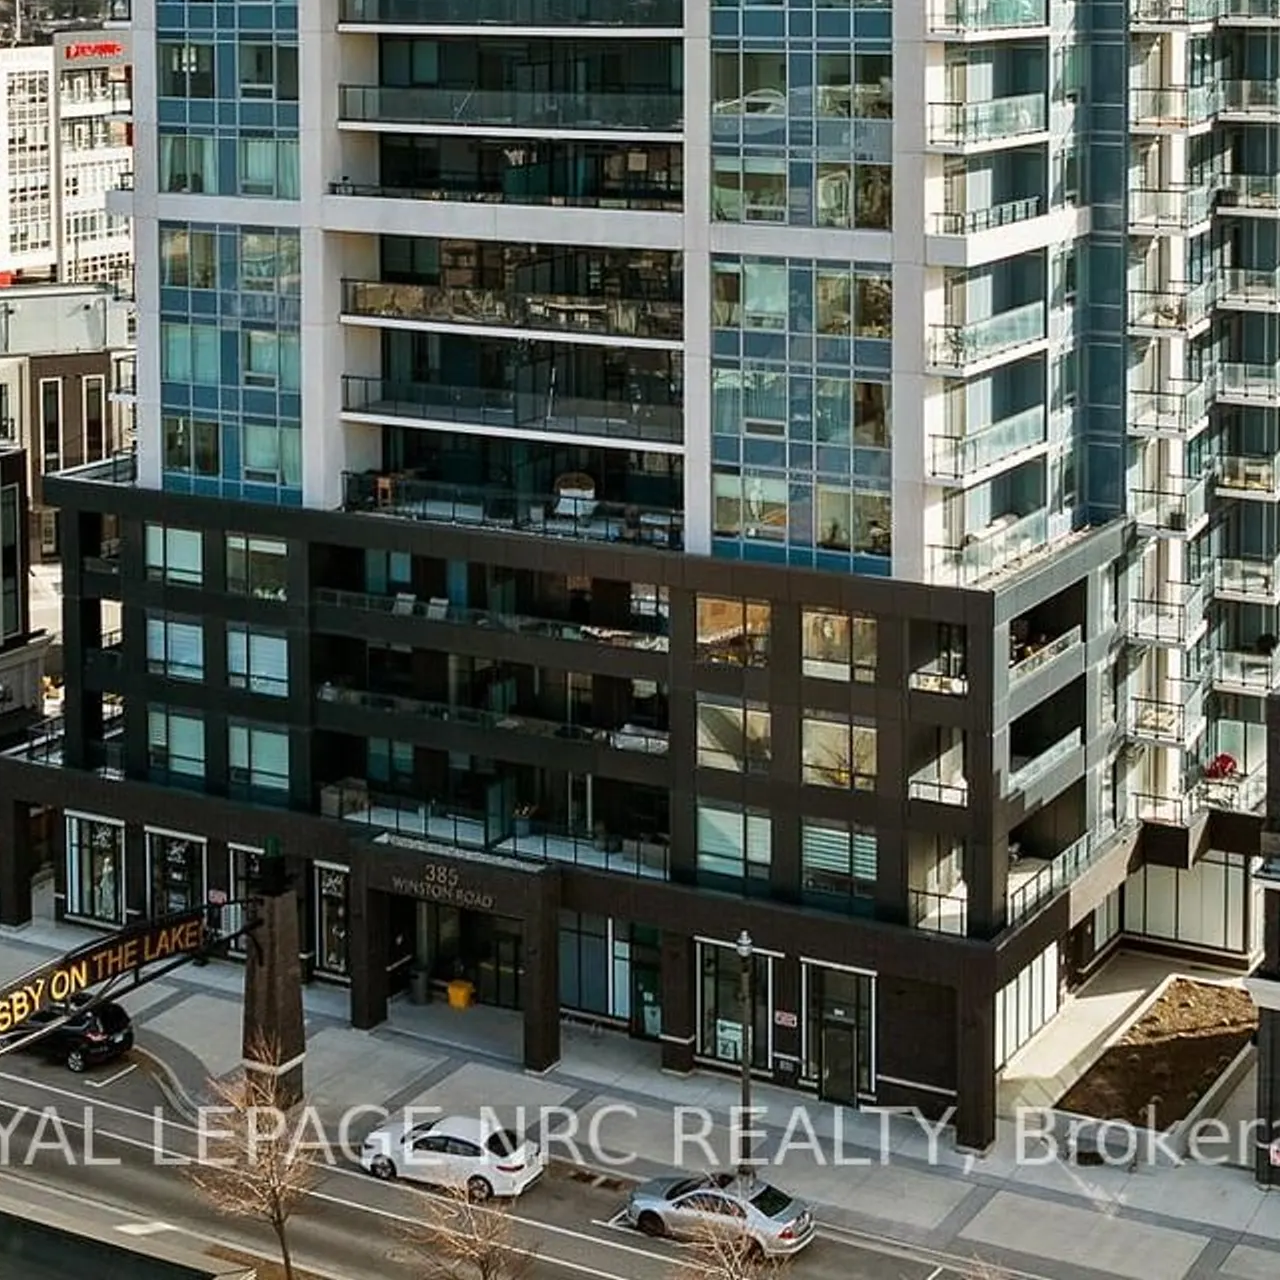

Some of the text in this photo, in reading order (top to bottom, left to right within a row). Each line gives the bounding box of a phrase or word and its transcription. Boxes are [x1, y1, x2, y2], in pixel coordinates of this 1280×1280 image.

[425, 864, 459, 887] 385
[392, 876, 494, 908] WINSTON ROAD
[51, 961, 88, 1000] ON
[94, 939, 138, 979] THE
[143, 920, 199, 957] LAKE
